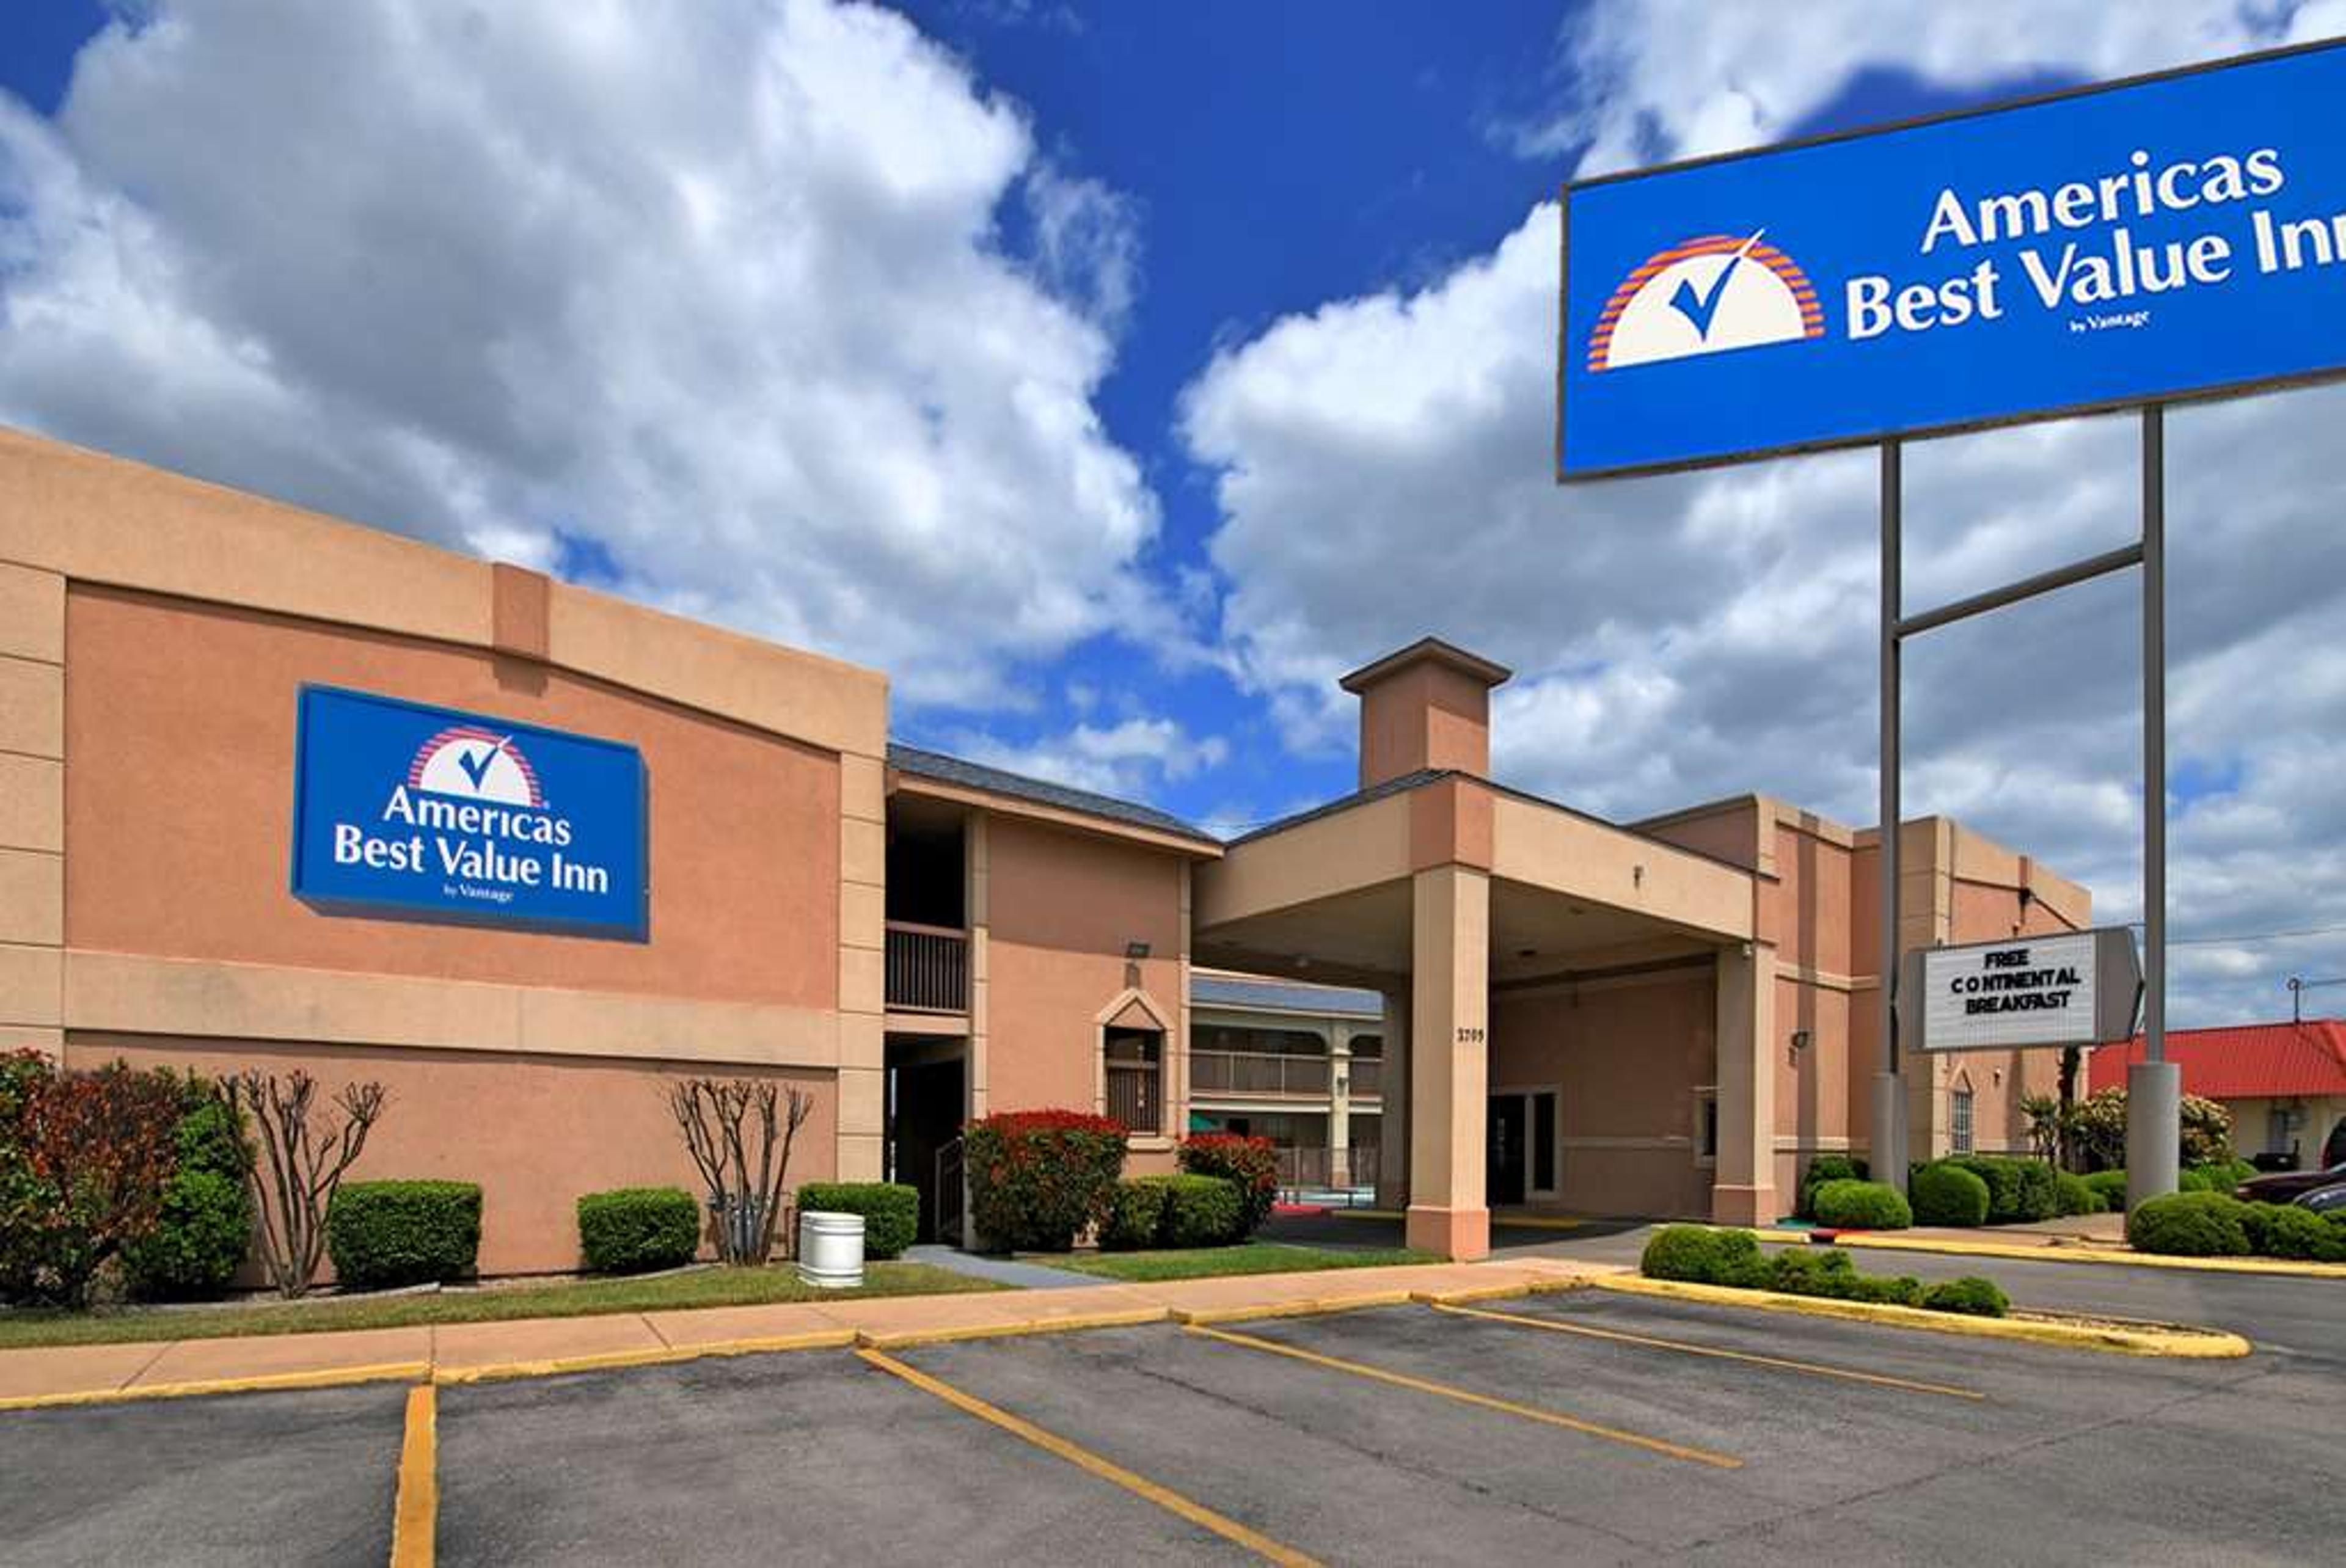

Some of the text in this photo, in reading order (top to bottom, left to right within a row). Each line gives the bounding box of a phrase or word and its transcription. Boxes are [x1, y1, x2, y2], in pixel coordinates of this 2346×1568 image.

[1921, 149, 2284, 253] Americas
[1846, 210, 2346, 339] Best Value In
[2086, 310, 2150, 330] Vantage
[382, 784, 571, 847] Americas
[334, 824, 608, 894] Best Value Inn
[459, 884, 514, 903] Vantage
[1984, 949, 2029, 969] FREE
[1965, 991, 2072, 1015] BREAKFAST
